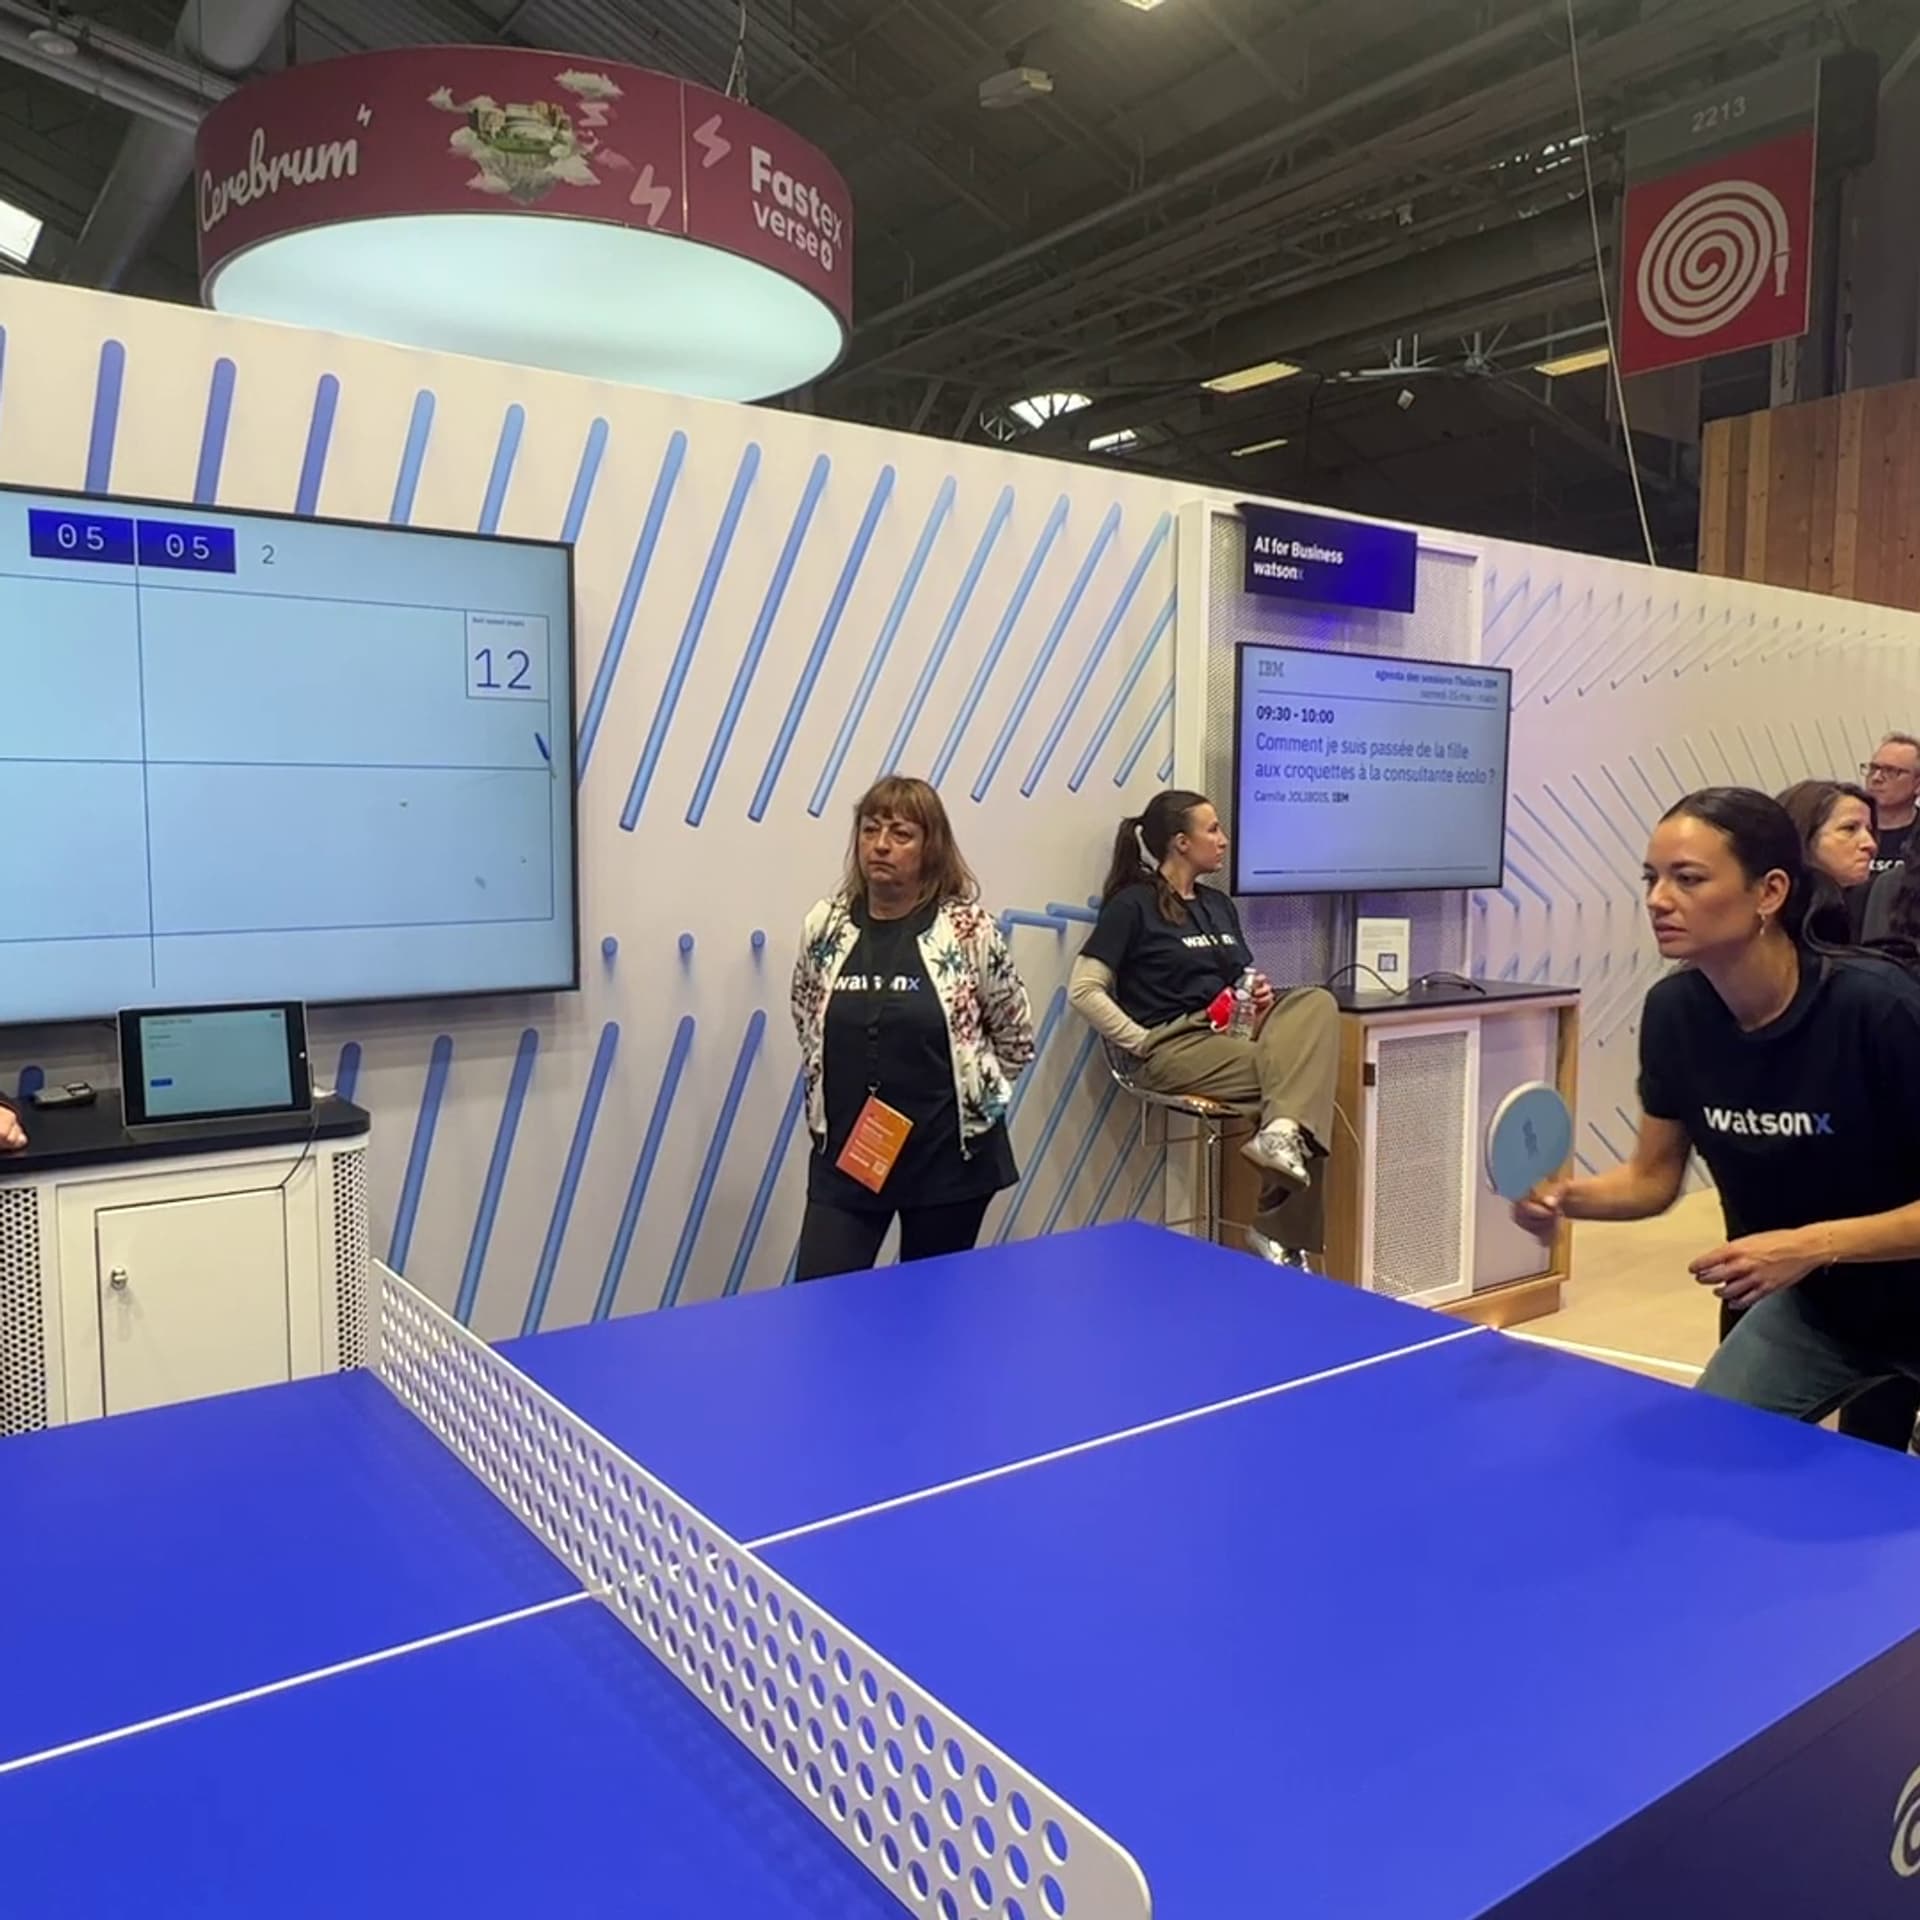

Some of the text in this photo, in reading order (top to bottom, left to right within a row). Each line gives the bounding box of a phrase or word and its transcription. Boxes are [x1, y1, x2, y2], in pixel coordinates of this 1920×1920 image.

[1691, 95, 1747, 134] 2213
[200, 127, 358, 233] Cerebrum
[751, 144, 843, 251] Fastex
[752, 200, 818, 258] verse
[57, 523, 276, 565] 05 05 2
[1254, 536, 1344, 565] AI for Business
[475, 648, 532, 691] 12
[1258, 660, 1285, 678] IBM
[1256, 705, 1292, 722] 09:30
[1301, 708, 1335, 724] 10:00
[1256, 732, 1470, 760] Comment je suis passée de la fille
[1255, 762, 1497, 785] aux croquettes à la consultante écolo ?
[1254, 789, 1286, 803] Camille
[1331, 791, 1350, 804] IBM
[1703, 1106, 1835, 1137] watsonx
